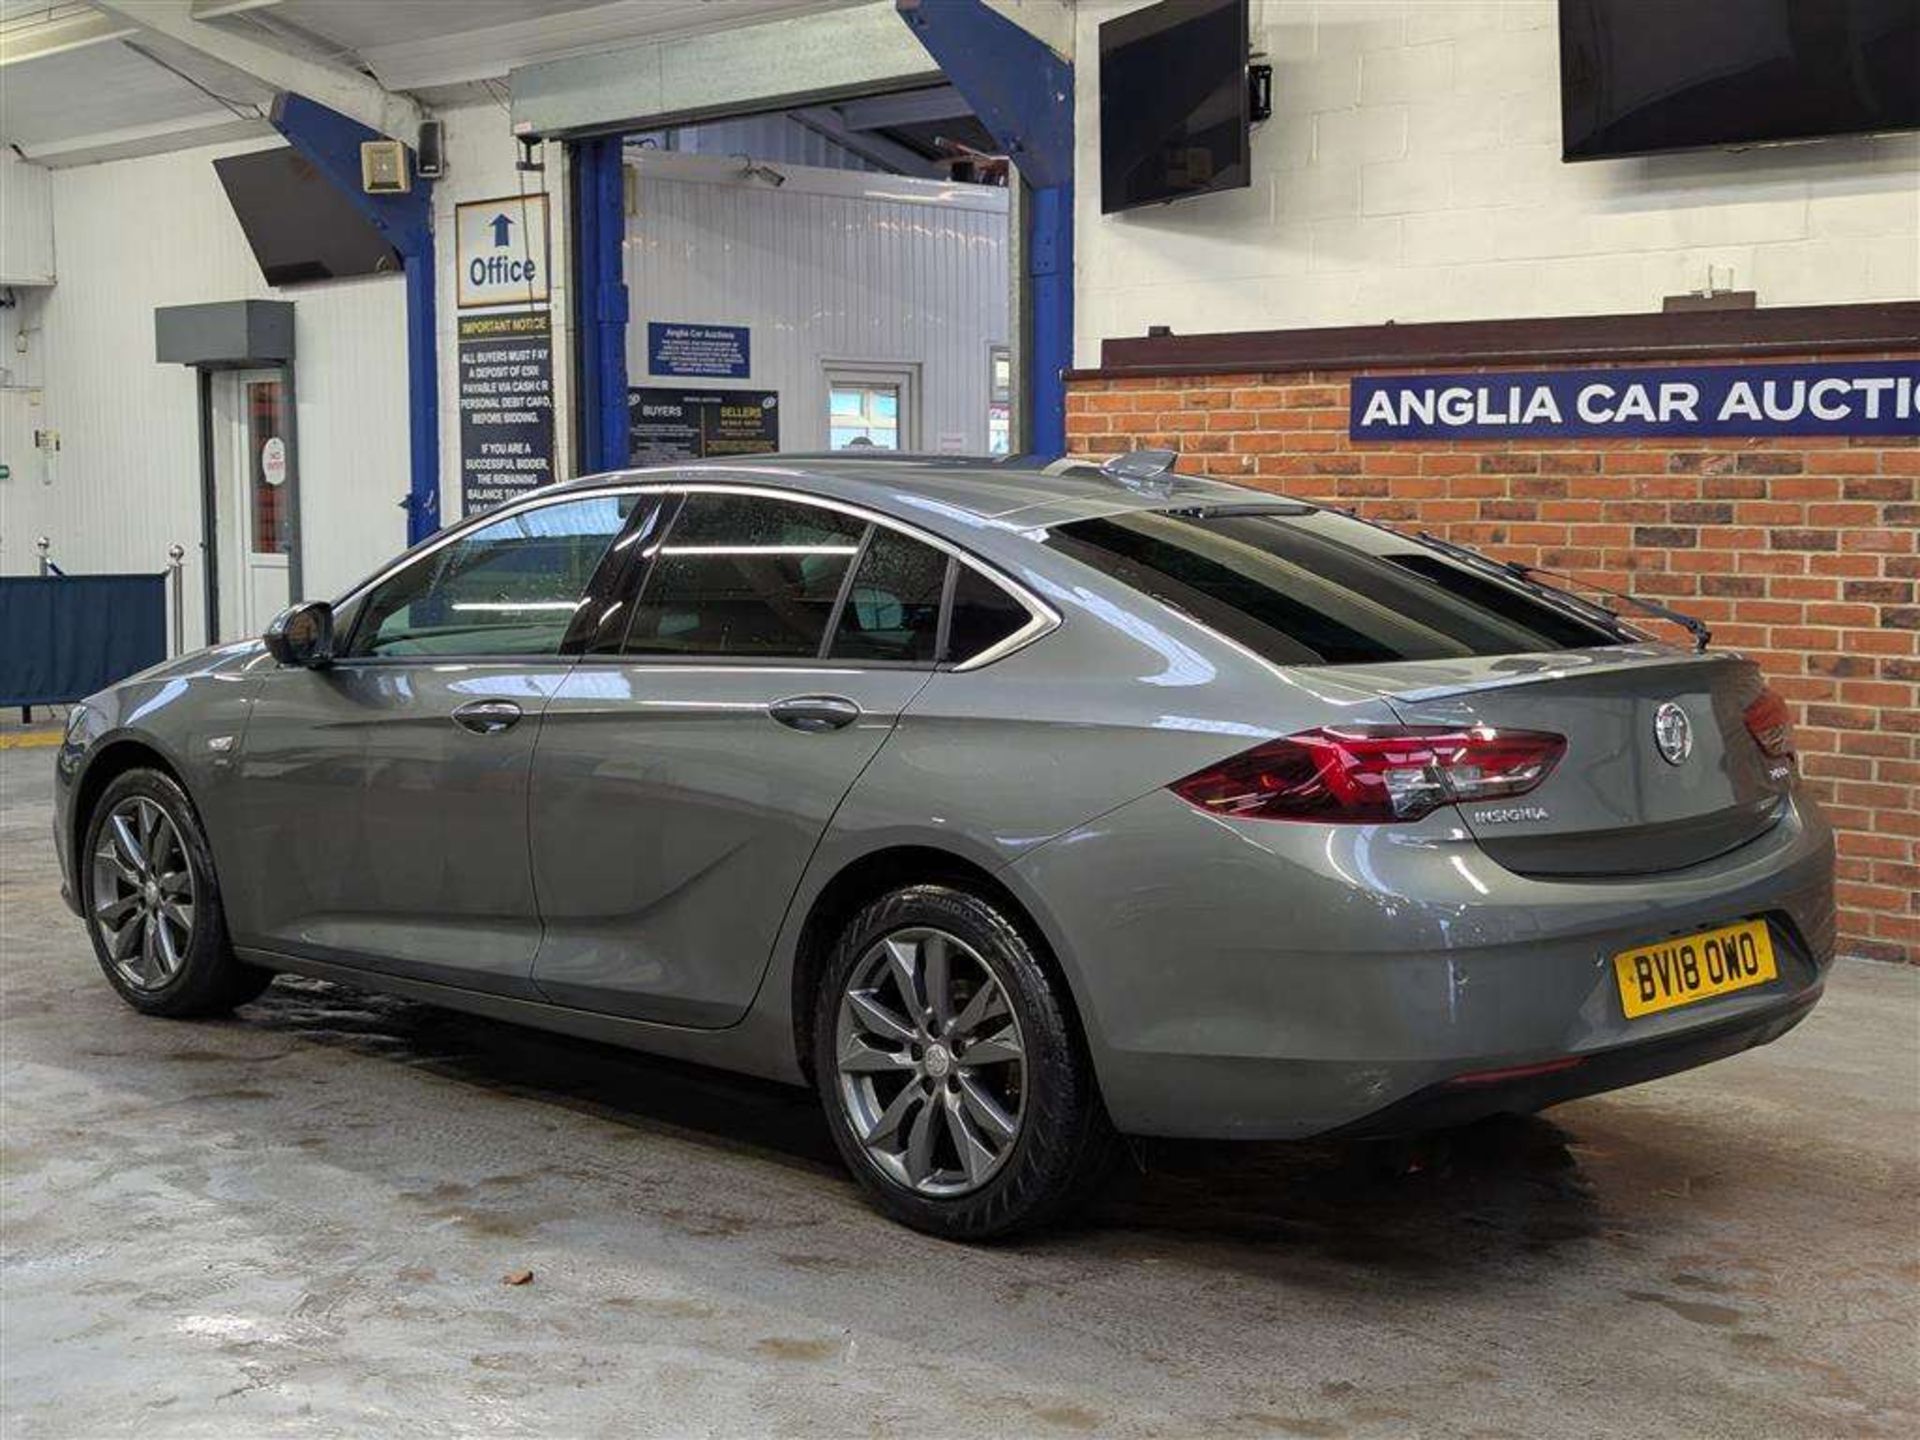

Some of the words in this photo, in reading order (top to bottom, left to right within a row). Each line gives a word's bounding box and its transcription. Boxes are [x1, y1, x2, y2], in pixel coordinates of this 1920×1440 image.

[469, 256, 536, 287] Office
[462, 319, 511, 334] IMPORTANT
[512, 317, 546, 330] NOTICE
[462, 353, 475, 364] ALL
[477, 351, 508, 363] BUYERS
[508, 350, 530, 362] MUST
[468, 367, 474, 378] A
[476, 366, 509, 378] DEPOSIT
[510, 366, 521, 377] OF
[462, 382, 496, 394] PAYABLE
[498, 382, 511, 392] VIA
[512, 381, 534, 392] CASH
[461, 398, 500, 409] PERSONAL
[501, 397, 524, 408] DEBIT
[1360, 386, 1563, 426] ANGLIA
[1576, 382, 1700, 423] CAR
[1717, 377, 1920, 421] AUCTI
[642, 404, 682, 416] BUYERS
[720, 406, 762, 418] SELLERS
[472, 413, 502, 424] BEFORE
[481, 444, 488, 454] IF
[490, 443, 506, 454] YOU
[508, 443, 524, 454] ARE
[524, 443, 532, 454] A
[465, 458, 516, 470] SUCCESSFUL
[477, 474, 492, 484] THE
[493, 474, 538, 484] REMAINING
[467, 489, 504, 500] BALANCE
[468, 504, 481, 514] VIA
[1474, 806, 1549, 825] INSIGNIA
[1633, 944, 1700, 1003] BV18
[1705, 932, 1759, 984] OWO
